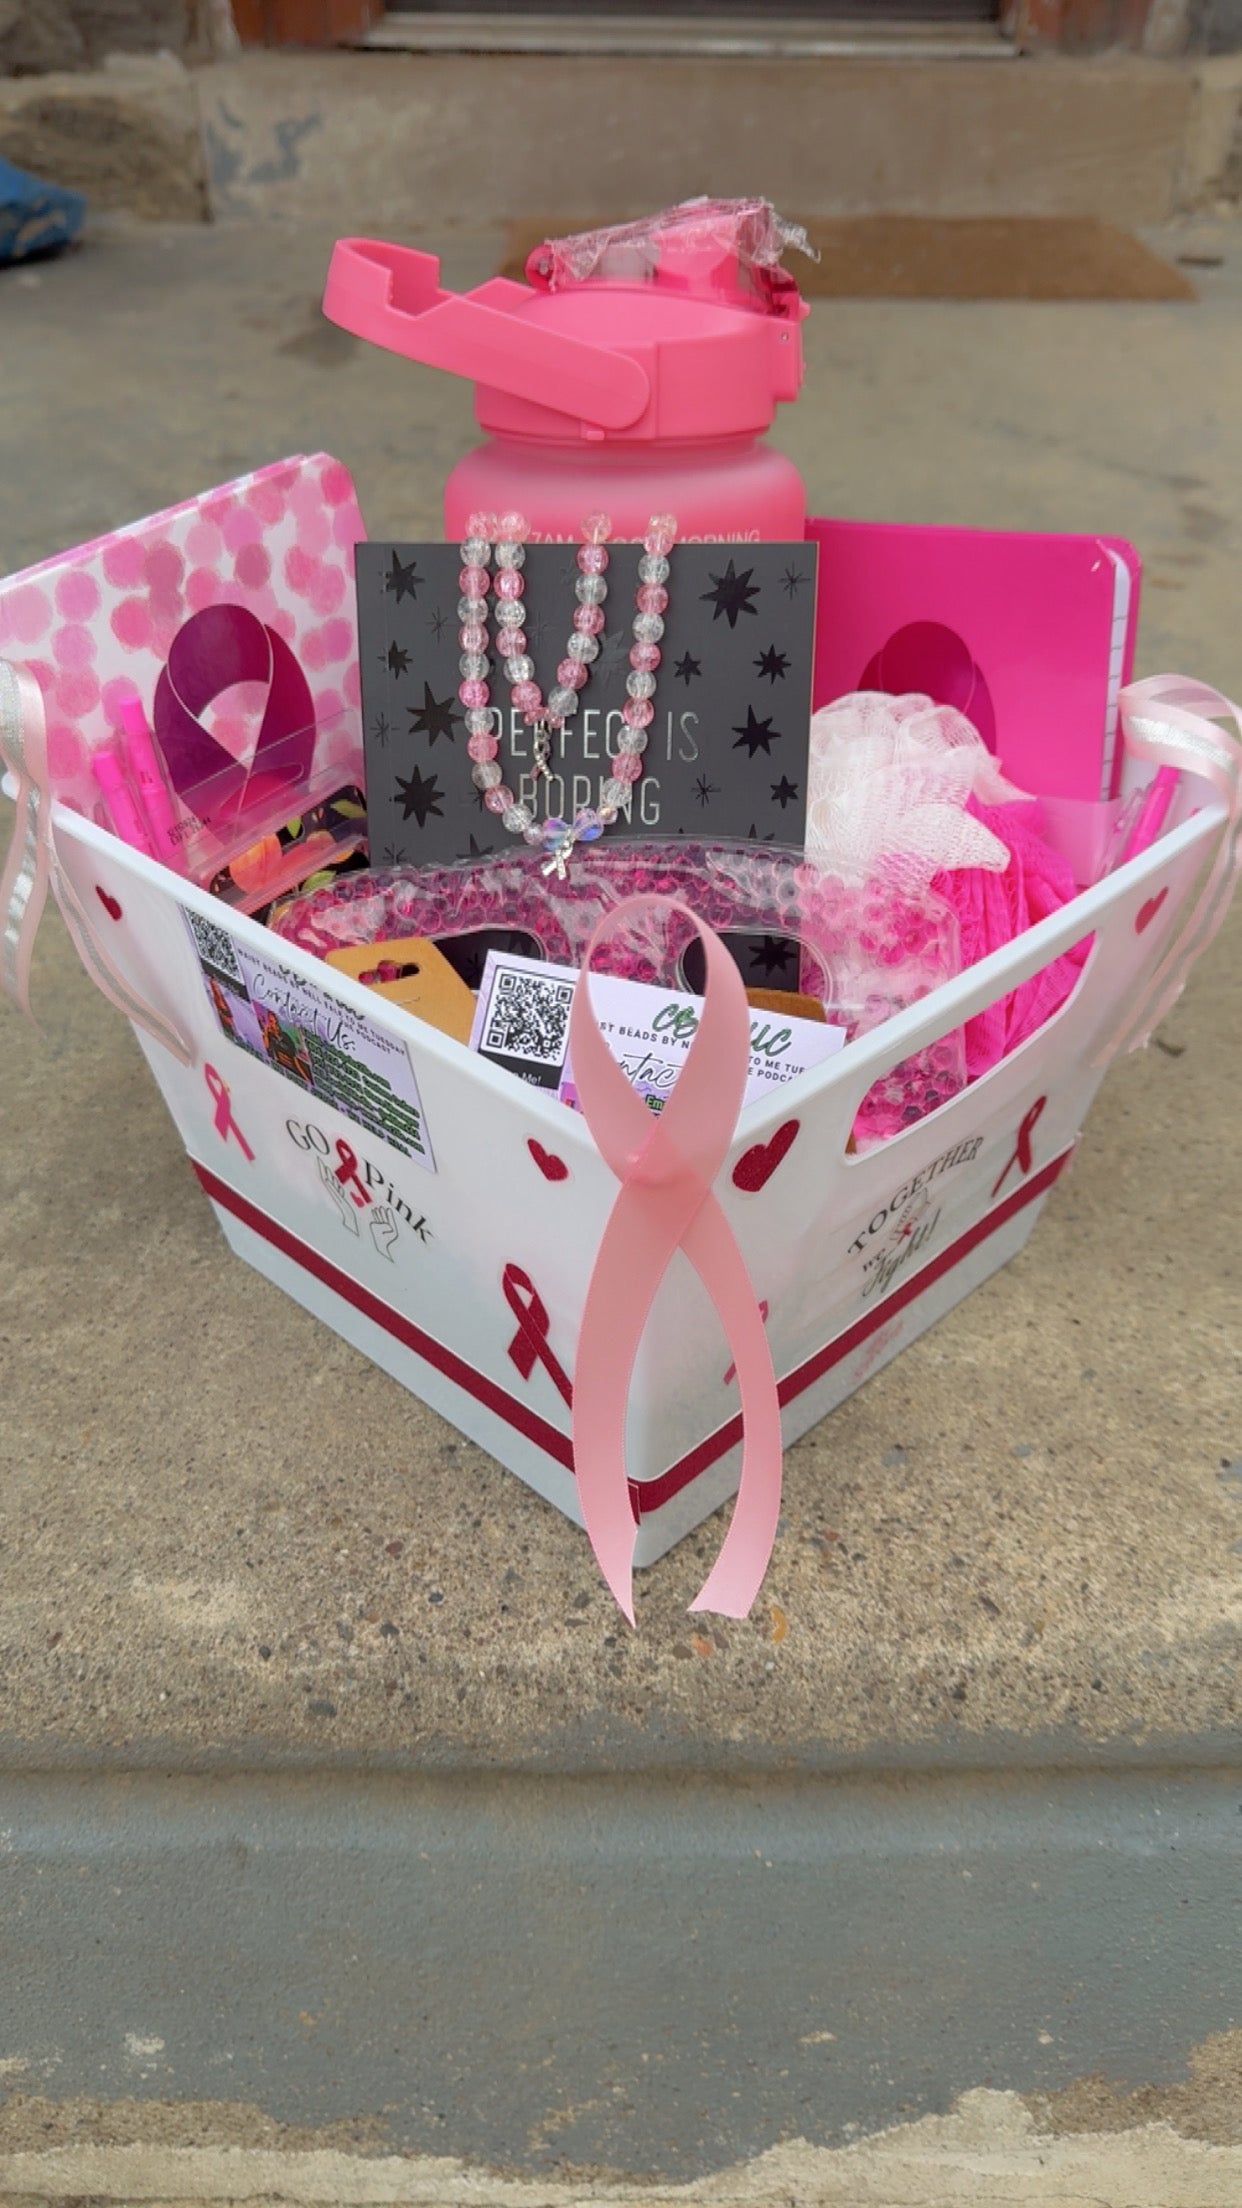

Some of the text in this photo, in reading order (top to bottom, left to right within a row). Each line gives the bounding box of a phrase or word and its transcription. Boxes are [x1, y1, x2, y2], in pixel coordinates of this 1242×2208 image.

[482, 706, 699, 762] PEFEC IS
[355, 1028, 391, 1054] PODCAST
[619, 1026, 658, 1043] BEADS
[662, 1035, 678, 1047] BY
[765, 1059, 782, 1071] ME
[285, 1119, 435, 1245] GO Pink
[847, 1136, 984, 1254] TOGETHER
